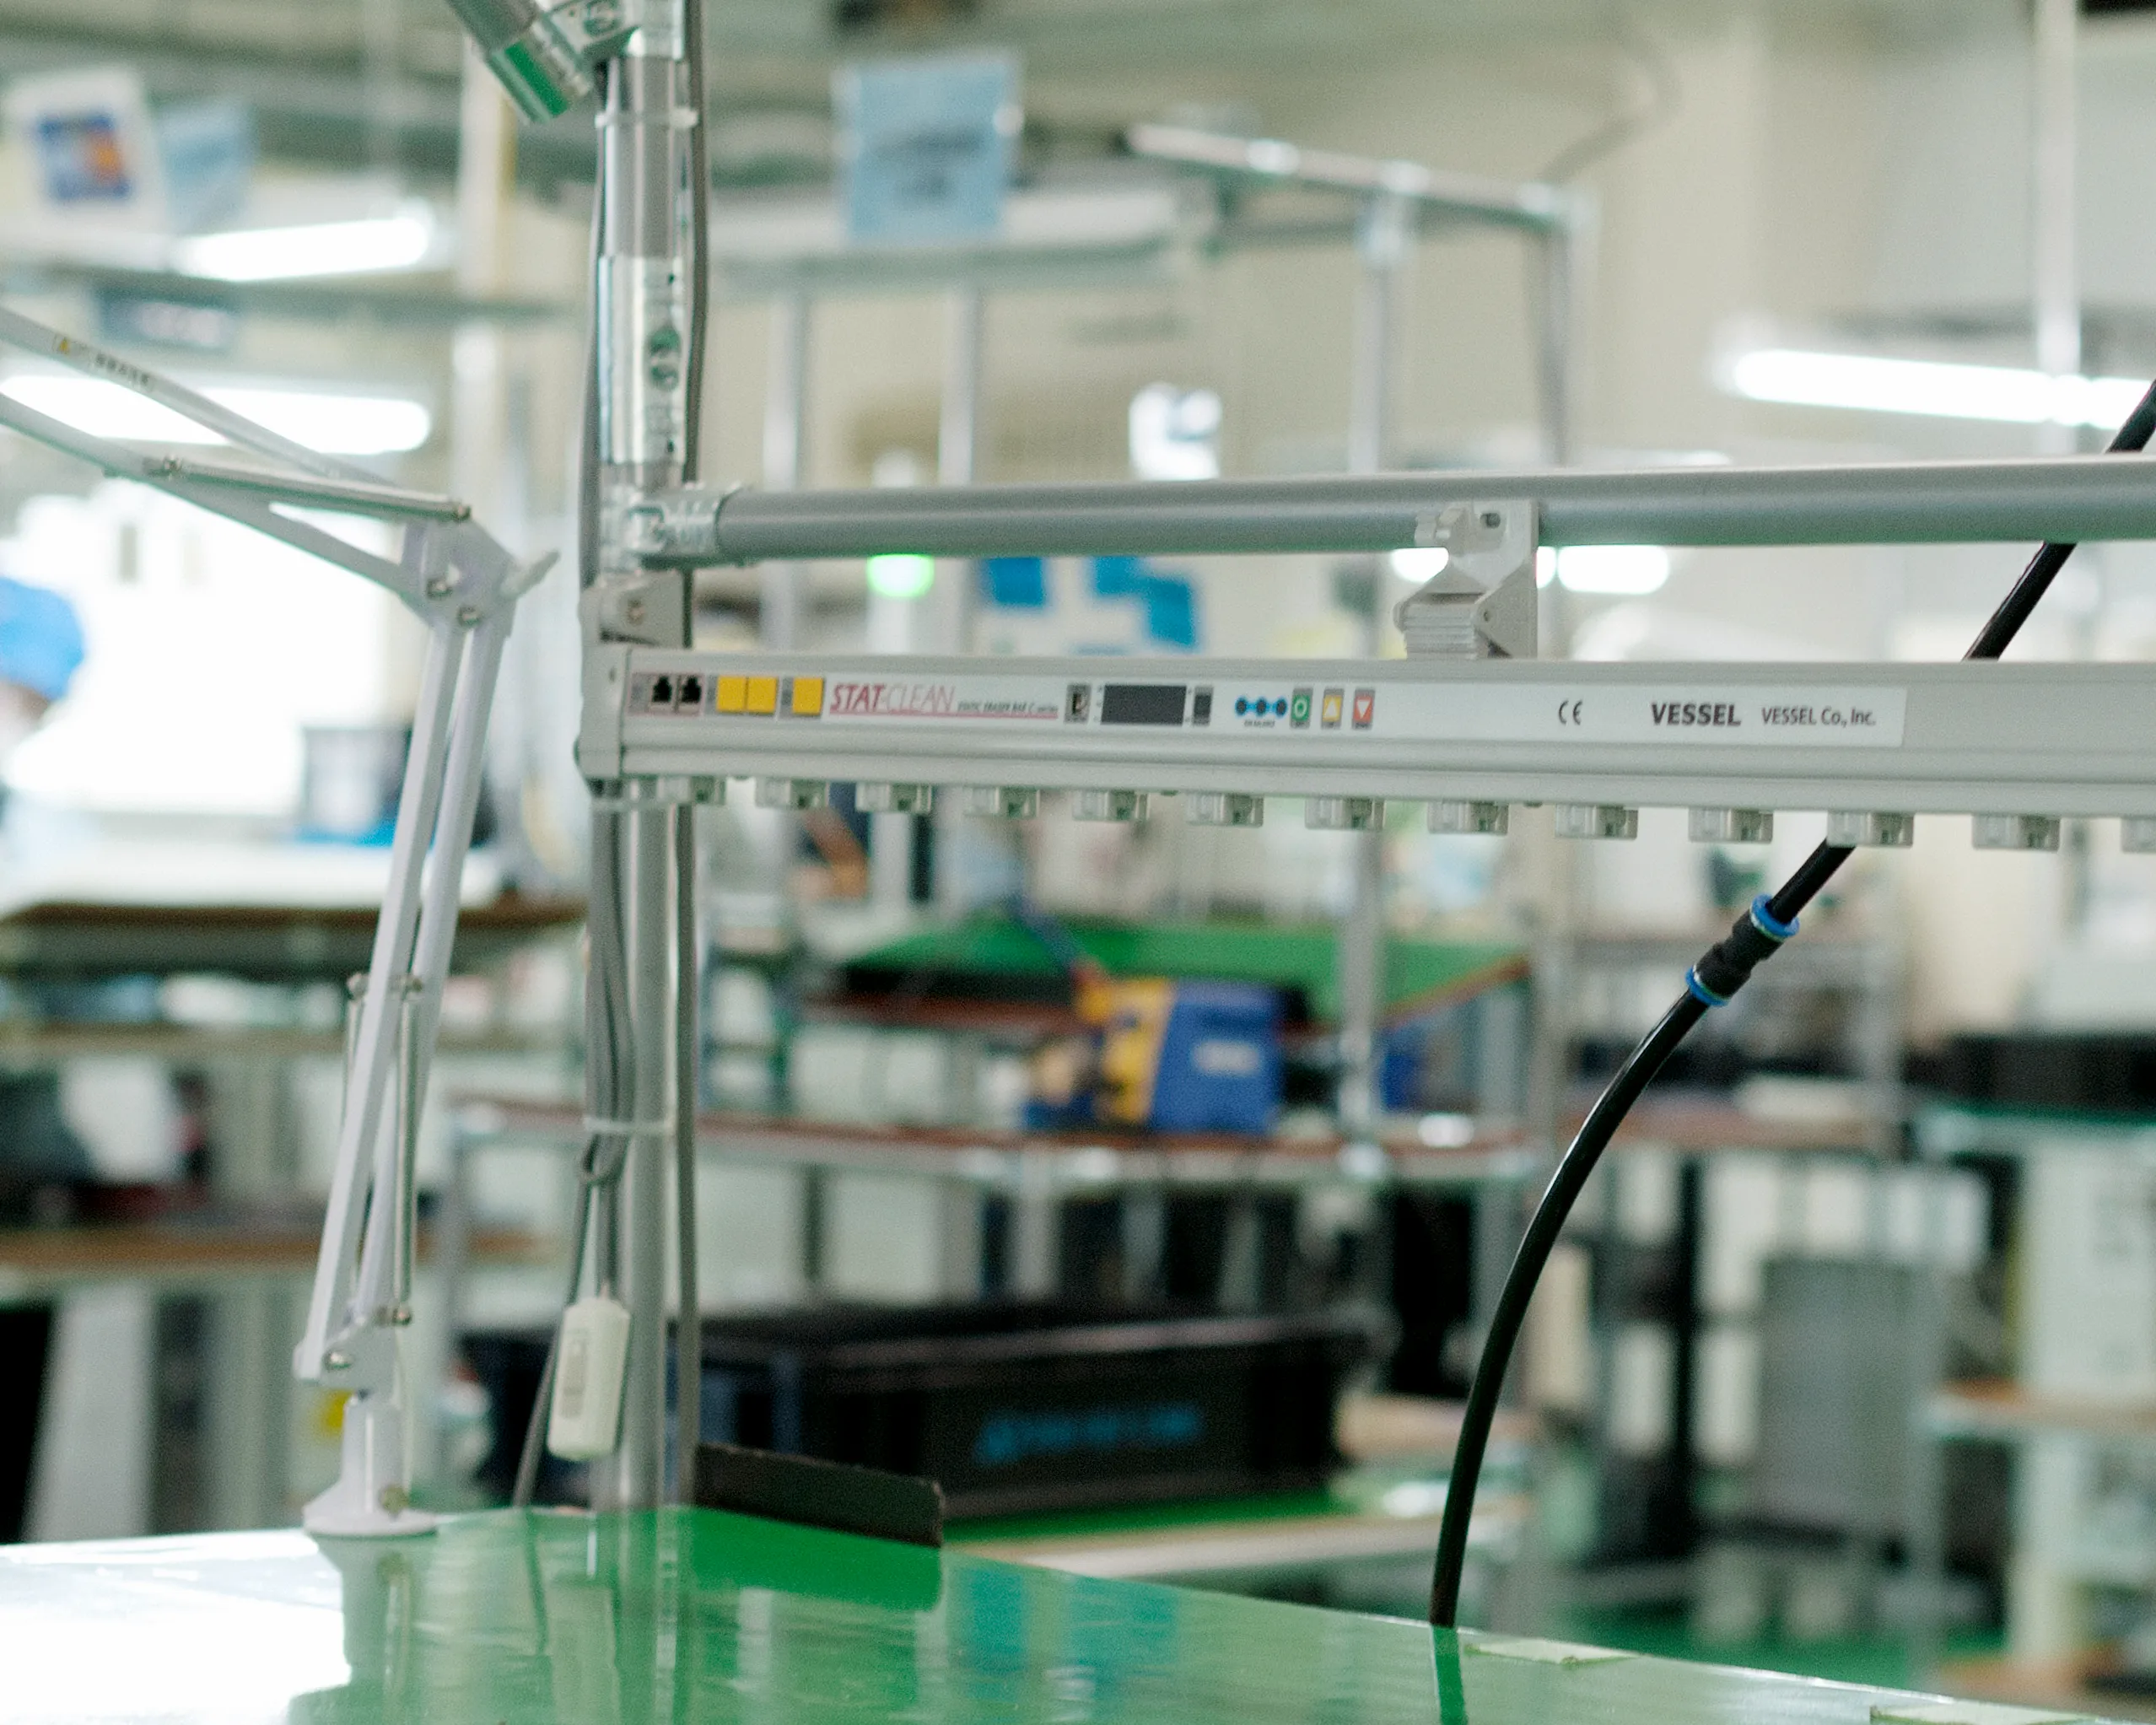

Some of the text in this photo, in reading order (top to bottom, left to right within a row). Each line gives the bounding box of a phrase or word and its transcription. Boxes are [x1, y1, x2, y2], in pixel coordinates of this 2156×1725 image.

[1651, 703, 1742, 726] VESSEL
[1760, 706, 1817, 725] VESSEL
[1851, 706, 1877, 726] Inc.
